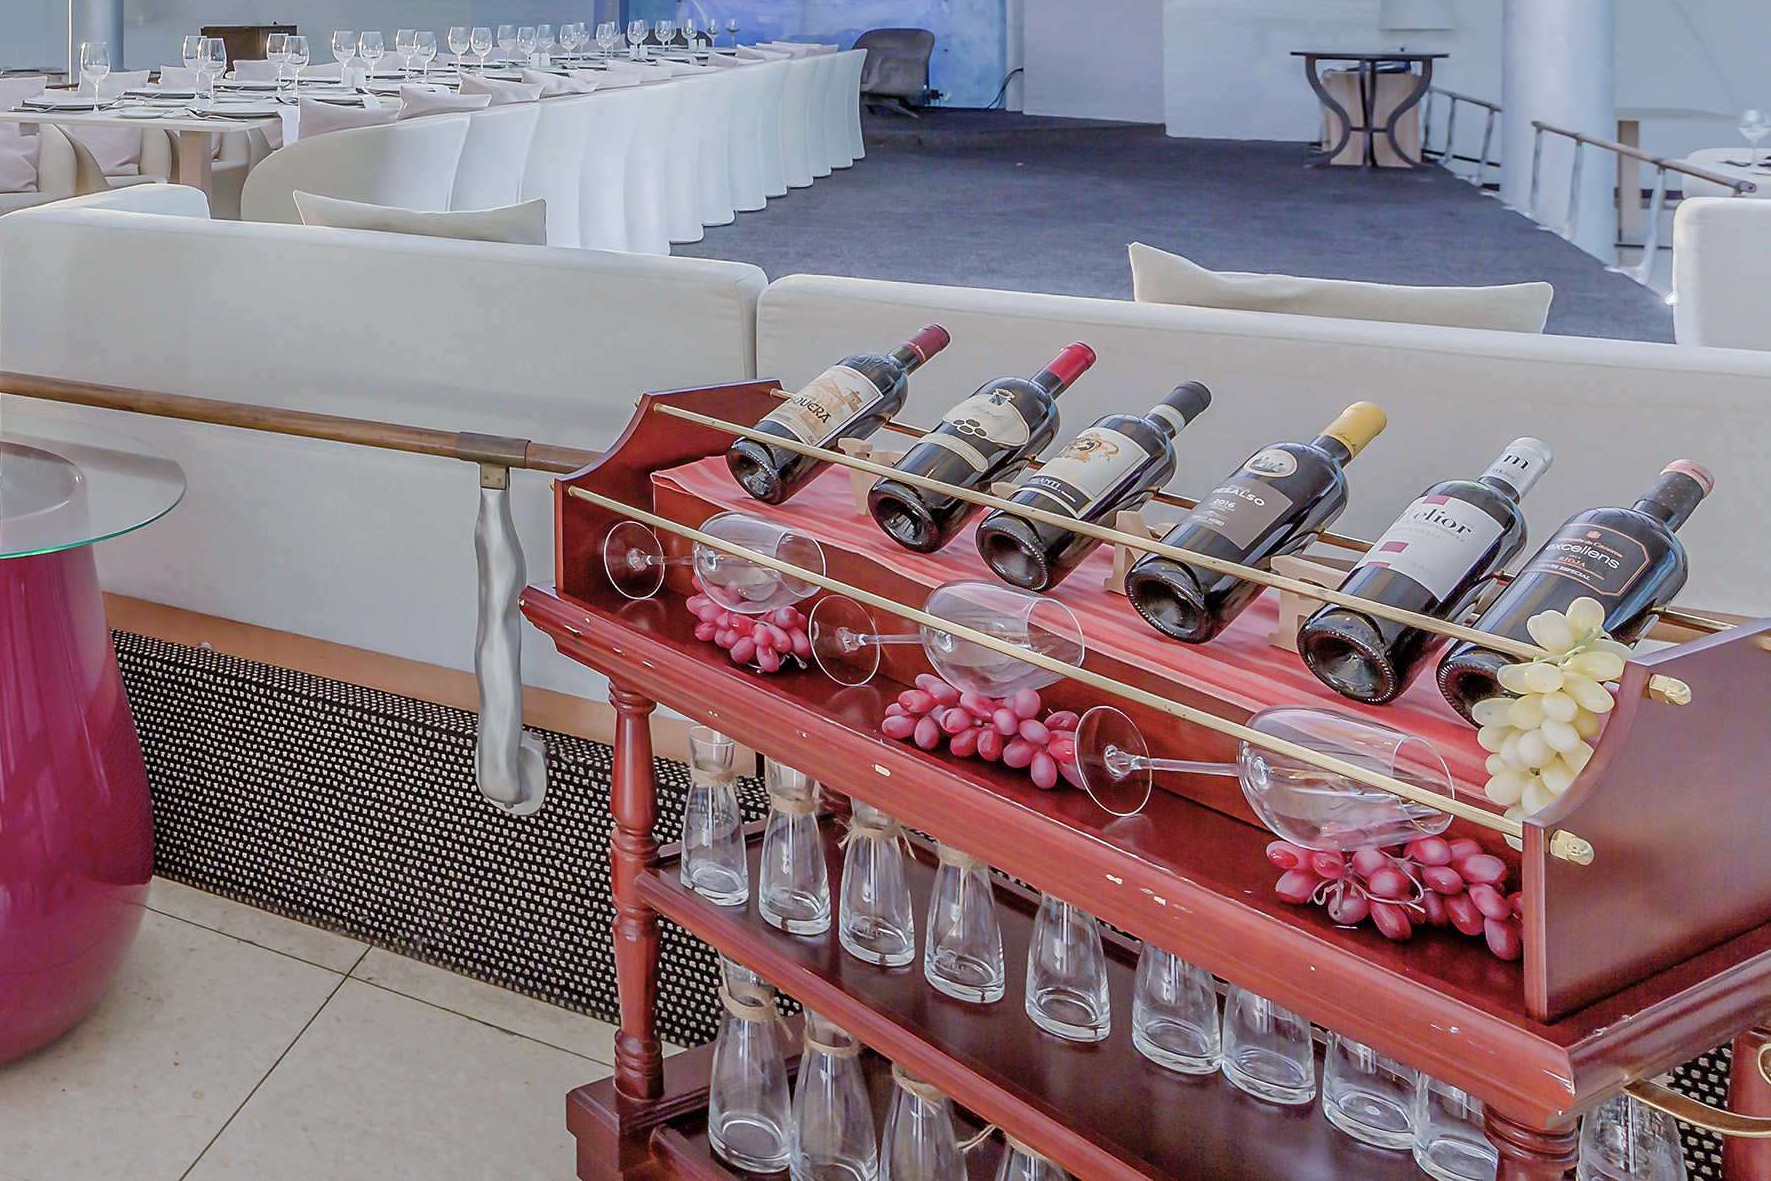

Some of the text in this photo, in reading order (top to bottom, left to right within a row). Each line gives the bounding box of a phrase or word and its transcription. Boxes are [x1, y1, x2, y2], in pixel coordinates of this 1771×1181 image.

[1397, 509, 1472, 534] elior
[1545, 543, 1620, 569] excellens
[1558, 556, 1585, 567] RIOJA
